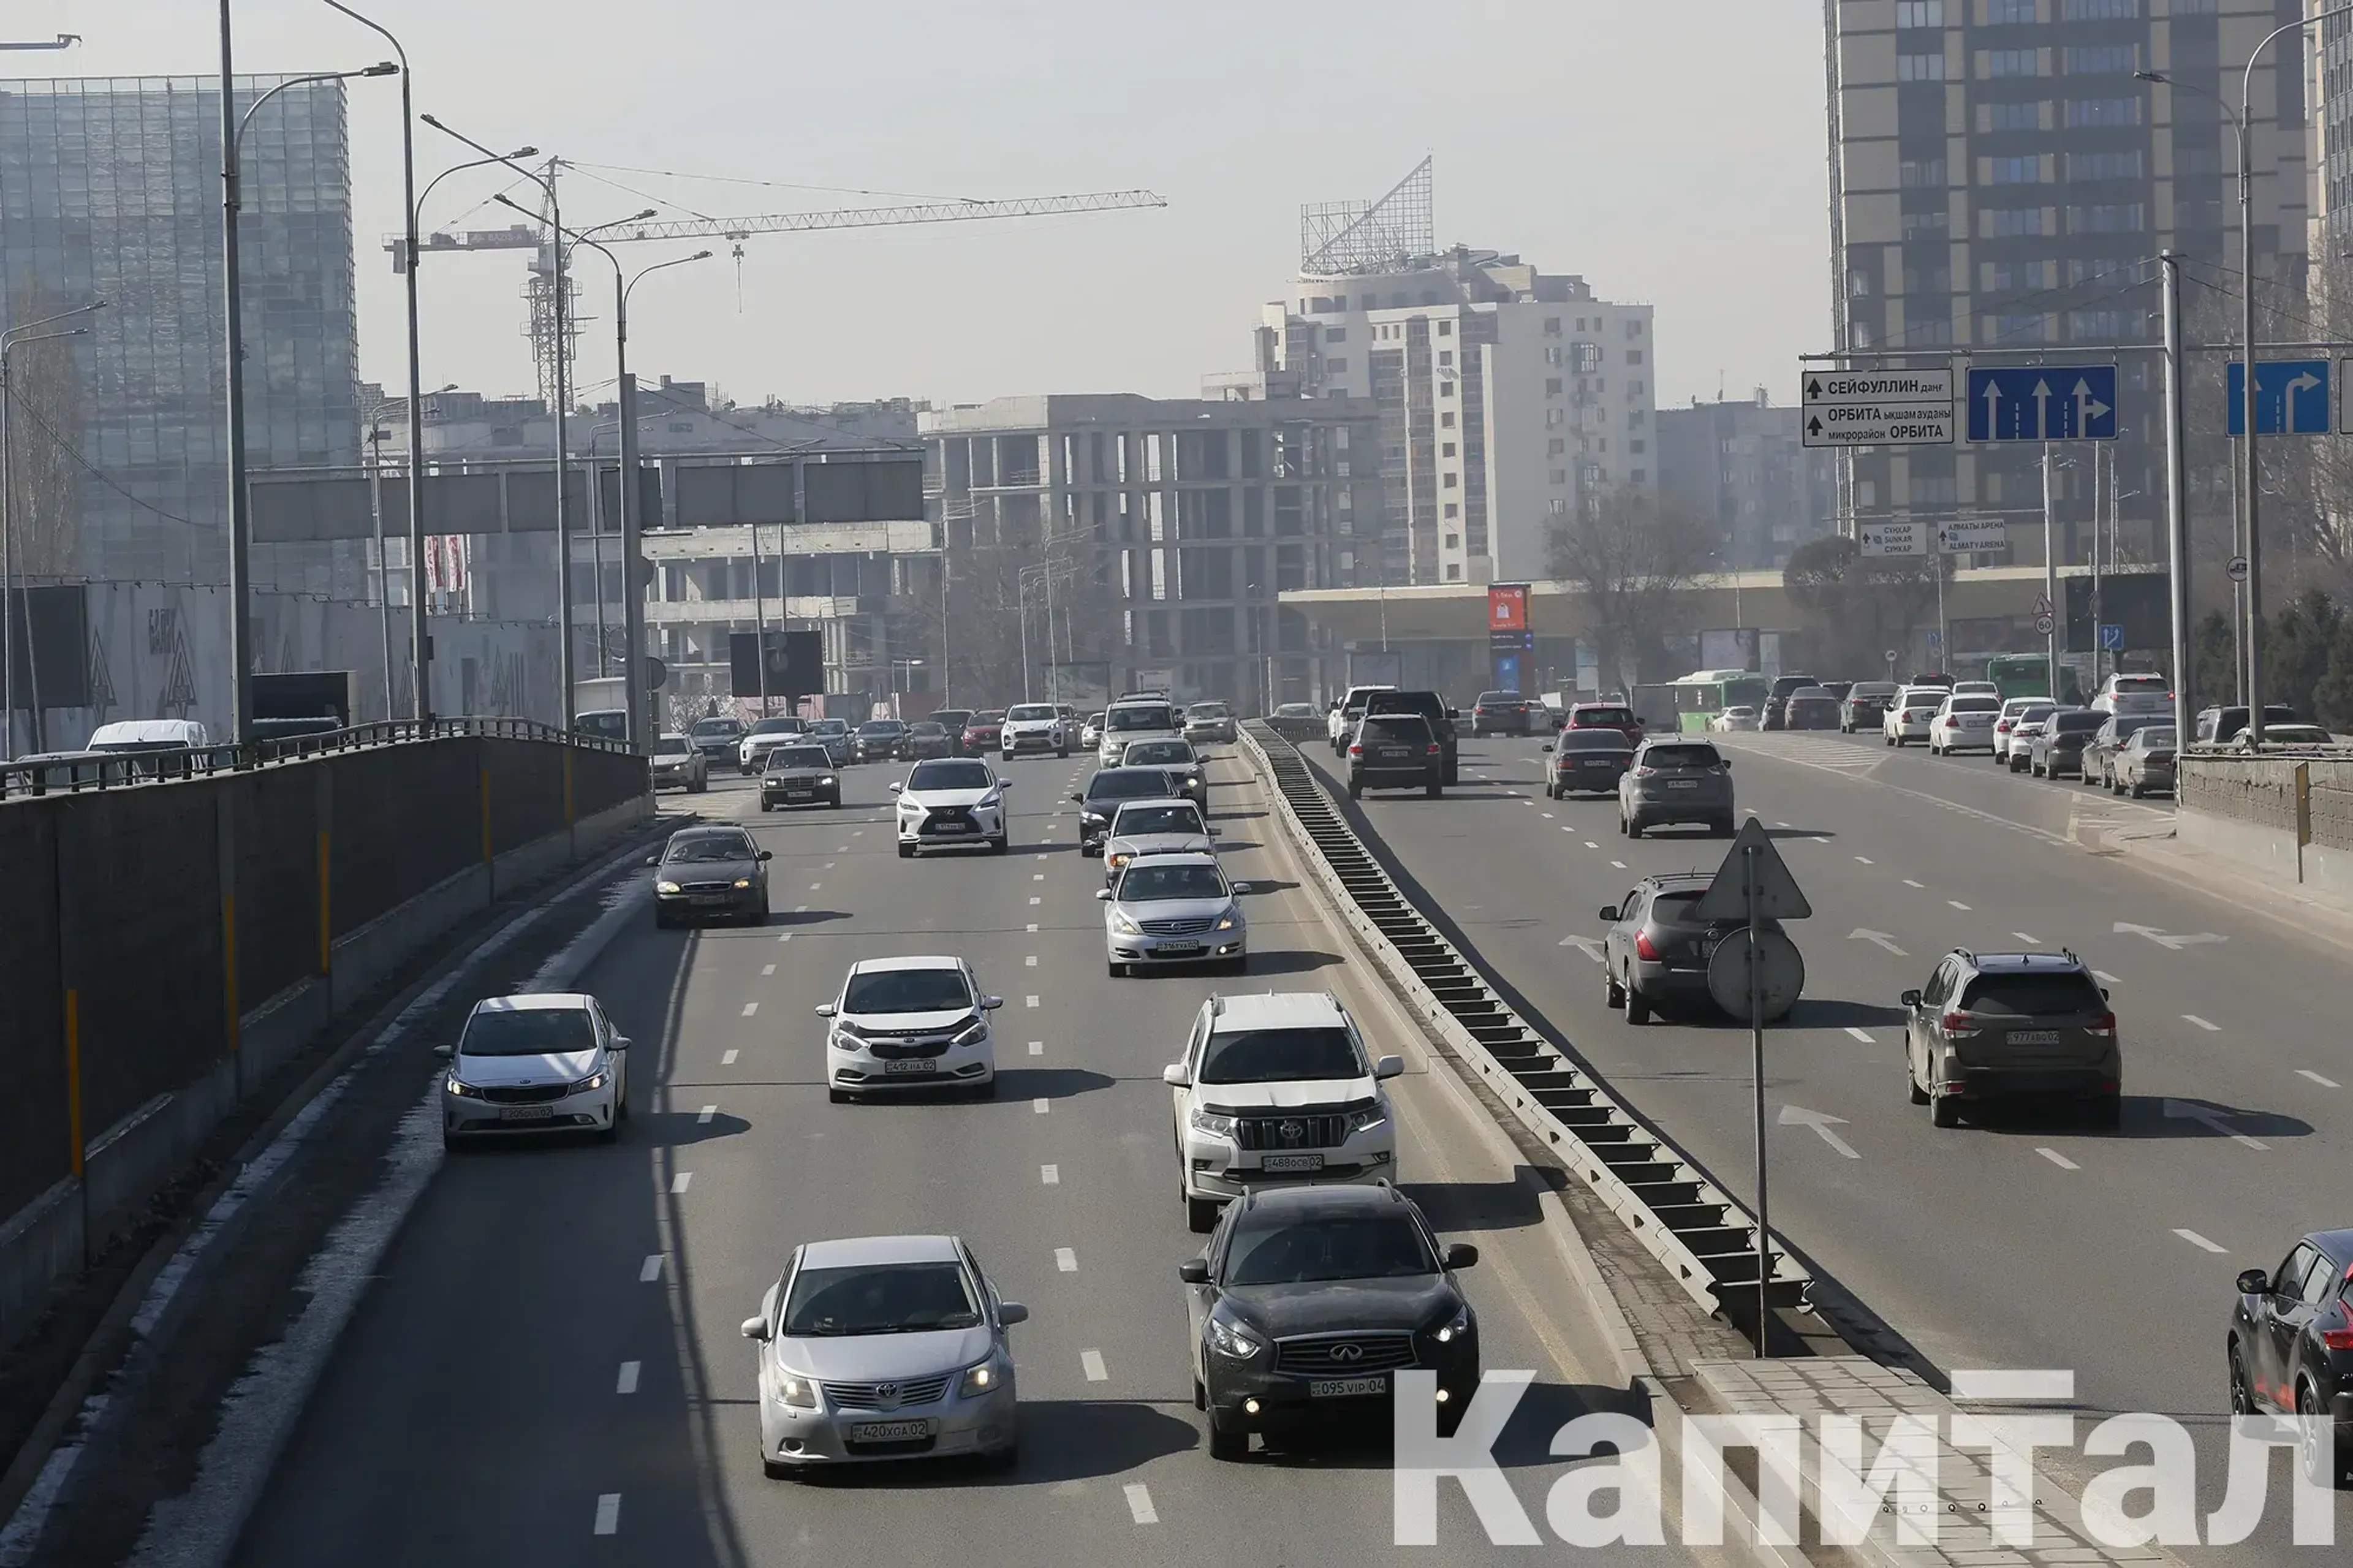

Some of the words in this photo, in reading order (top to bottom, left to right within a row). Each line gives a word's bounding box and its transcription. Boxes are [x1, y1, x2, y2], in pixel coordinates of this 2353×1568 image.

[1828, 378, 1918, 395] СЕЙФУЛЛИН
[1828, 407, 1881, 422] ОРБИТА
[1828, 429, 1885, 441] микрорайон
[1890, 425, 1944, 439] ОРБИТА
[1948, 523, 1980, 531] АЛМАТЫ
[1949, 541, 1979, 550] ALMATY
[1980, 540, 2005, 549] ARENA
[2039, 621, 2051, 631] 60
[1309, 1156, 1321, 1167] 02
[1321, 1381, 1345, 1395] 095
[1347, 1383, 1366, 1393] VIP
[1368, 1379, 1385, 1392] 04
[910, 1423, 926, 1435] 02
